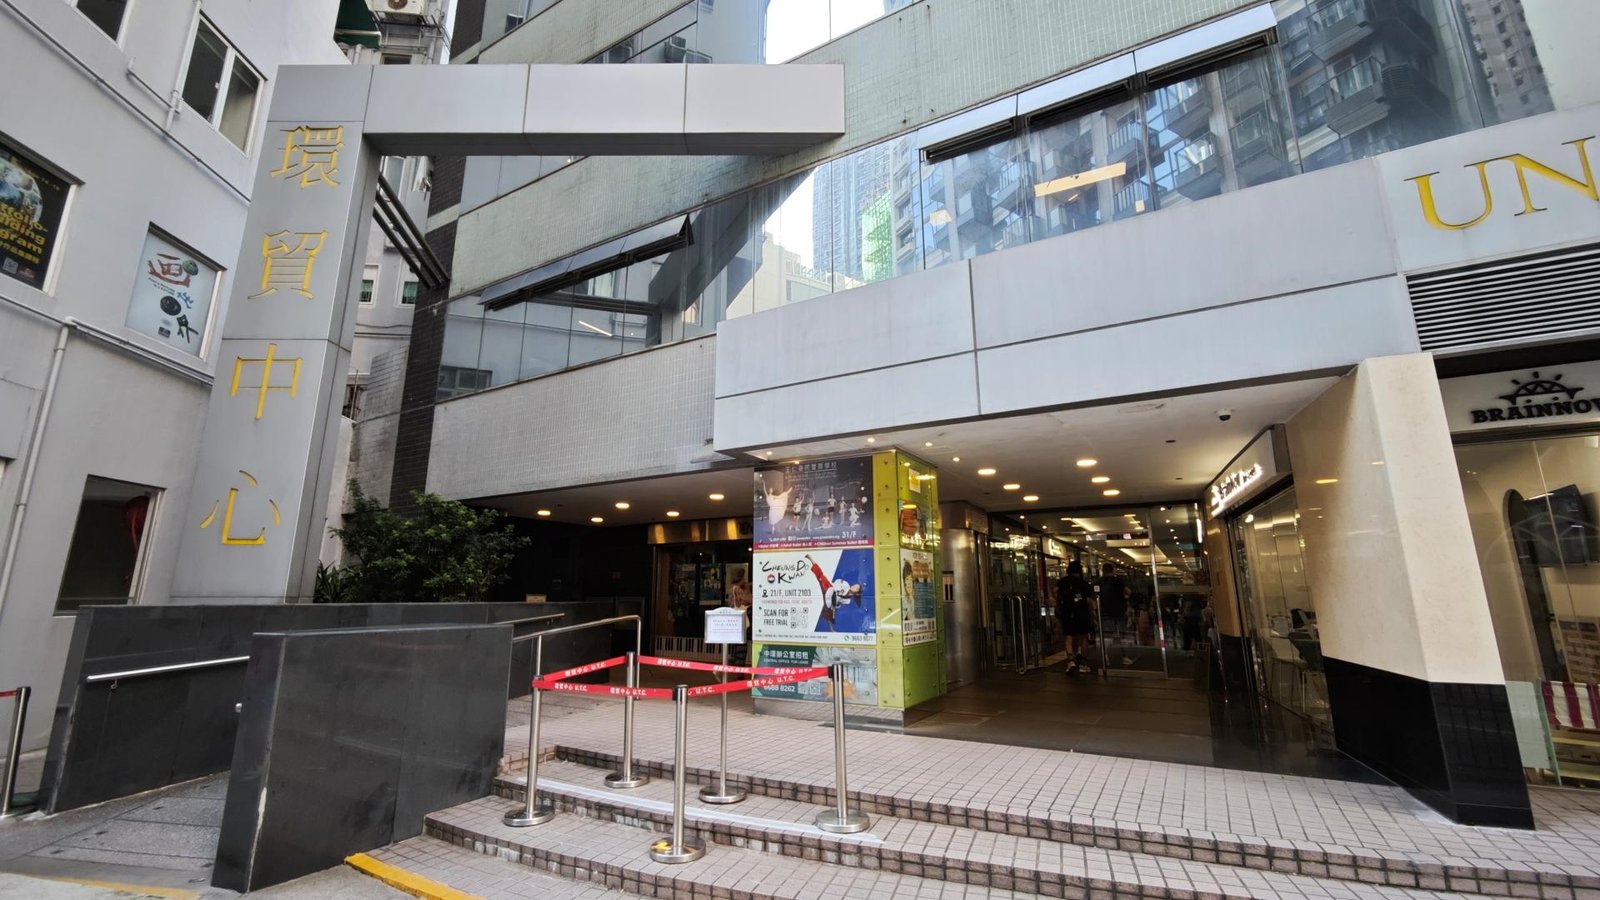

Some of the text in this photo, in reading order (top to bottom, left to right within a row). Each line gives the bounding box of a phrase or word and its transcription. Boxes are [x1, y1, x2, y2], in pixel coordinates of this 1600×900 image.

[200, 124, 344, 546] 環貿中心
[778, 572, 804, 584] KWAN
[785, 589, 797, 597] UNIT
[764, 608, 788, 617] SCAN FOR
[764, 618, 788, 626] FREE TRIAL
